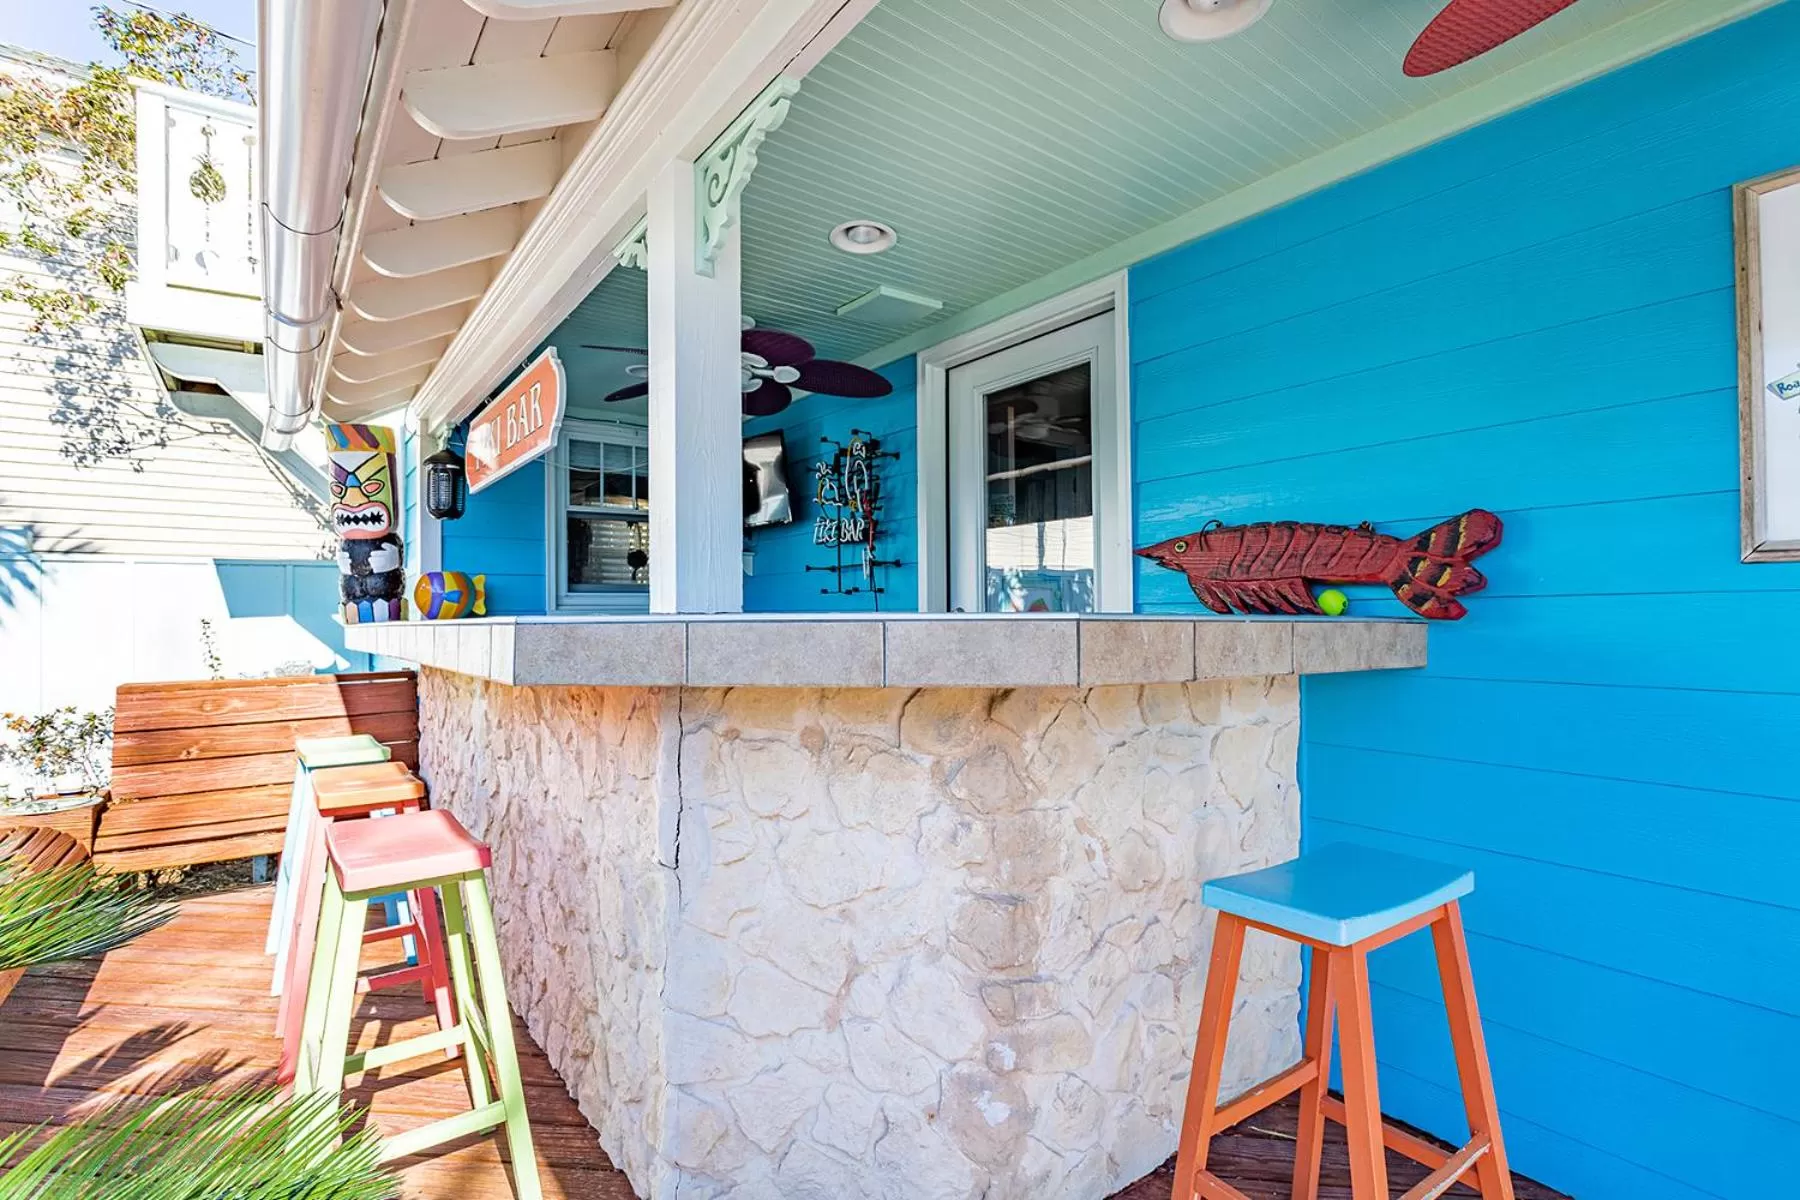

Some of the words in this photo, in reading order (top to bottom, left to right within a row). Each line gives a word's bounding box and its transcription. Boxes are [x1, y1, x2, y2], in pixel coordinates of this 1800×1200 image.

[506, 380, 544, 450] BAR
[813, 517, 838, 544] TIKI
[840, 517, 865, 542] BAR
